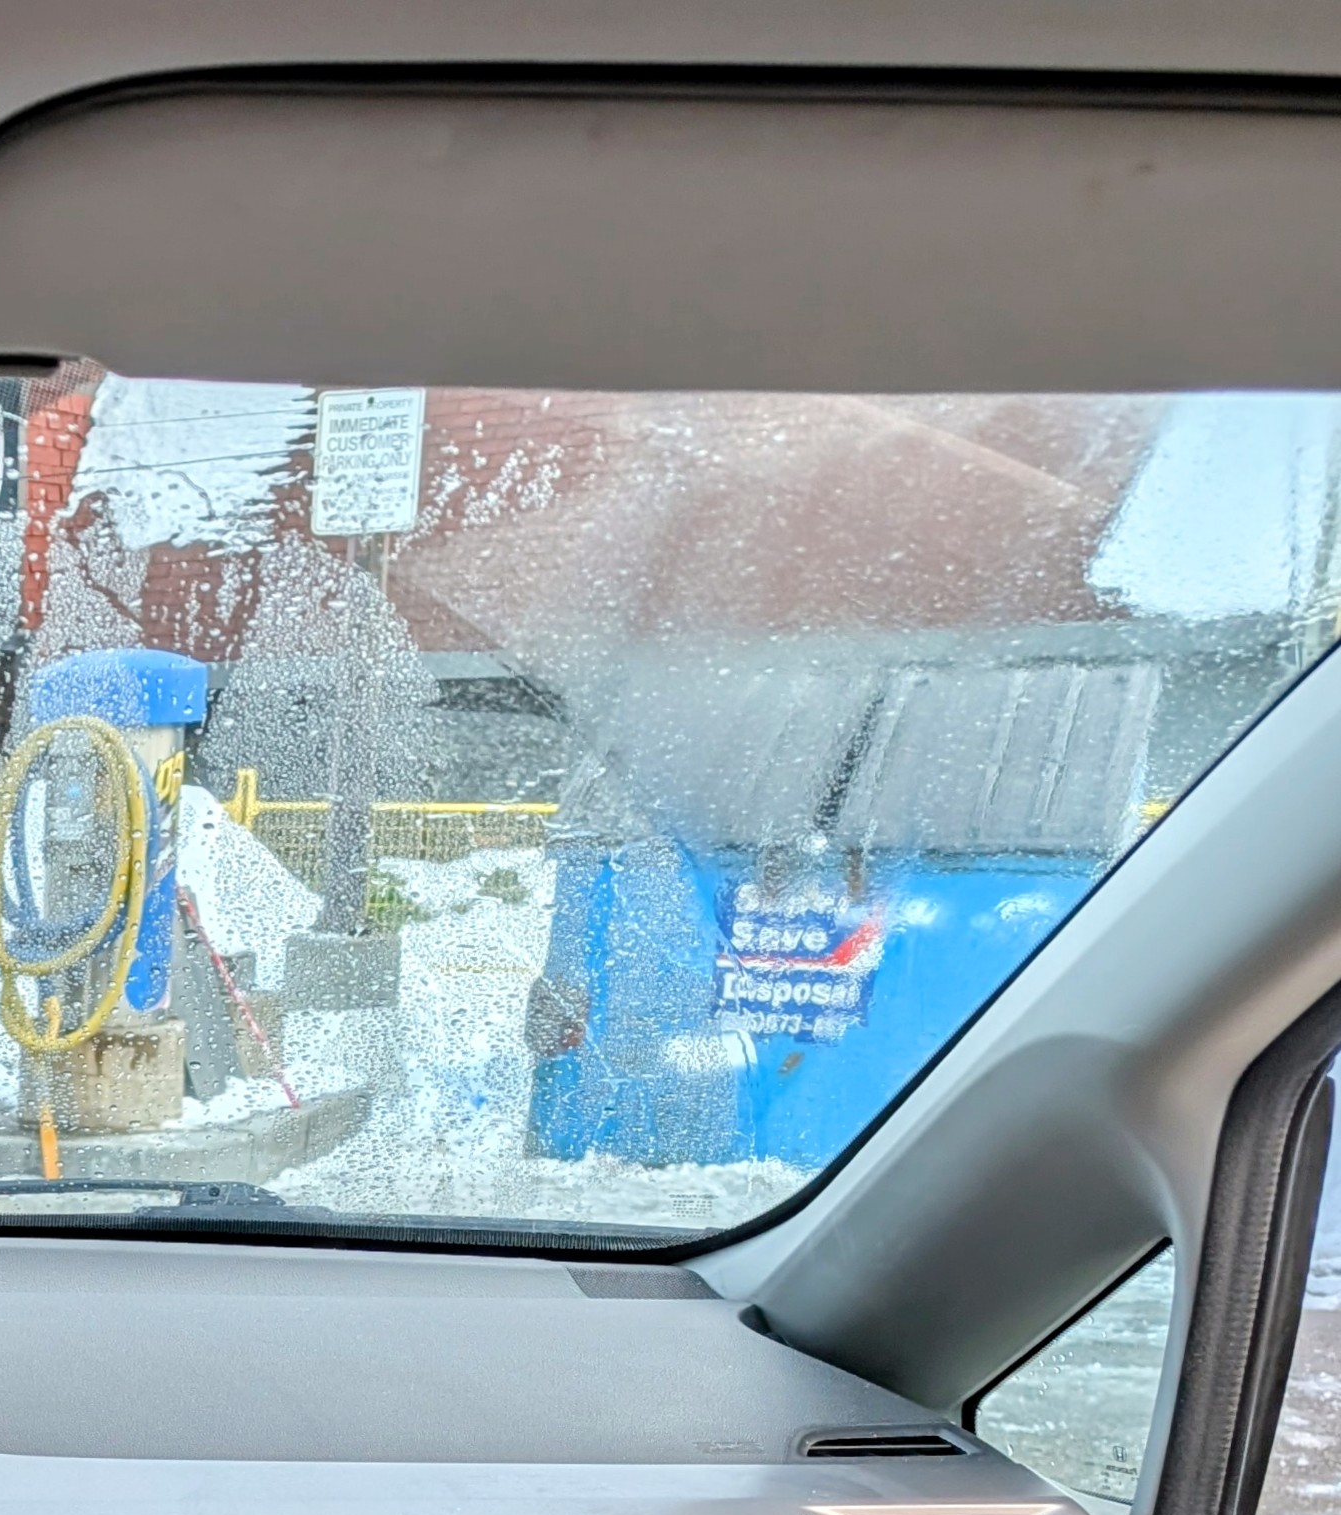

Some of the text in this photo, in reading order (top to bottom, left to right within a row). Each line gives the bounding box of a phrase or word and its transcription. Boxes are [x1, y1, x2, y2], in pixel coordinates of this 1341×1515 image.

[329, 414, 410, 433] IMMEDIATE
[326, 433, 410, 452] CUSTOMER
[321, 451, 412, 470] PARKING ONLY
[731, 921, 828, 952] Save
